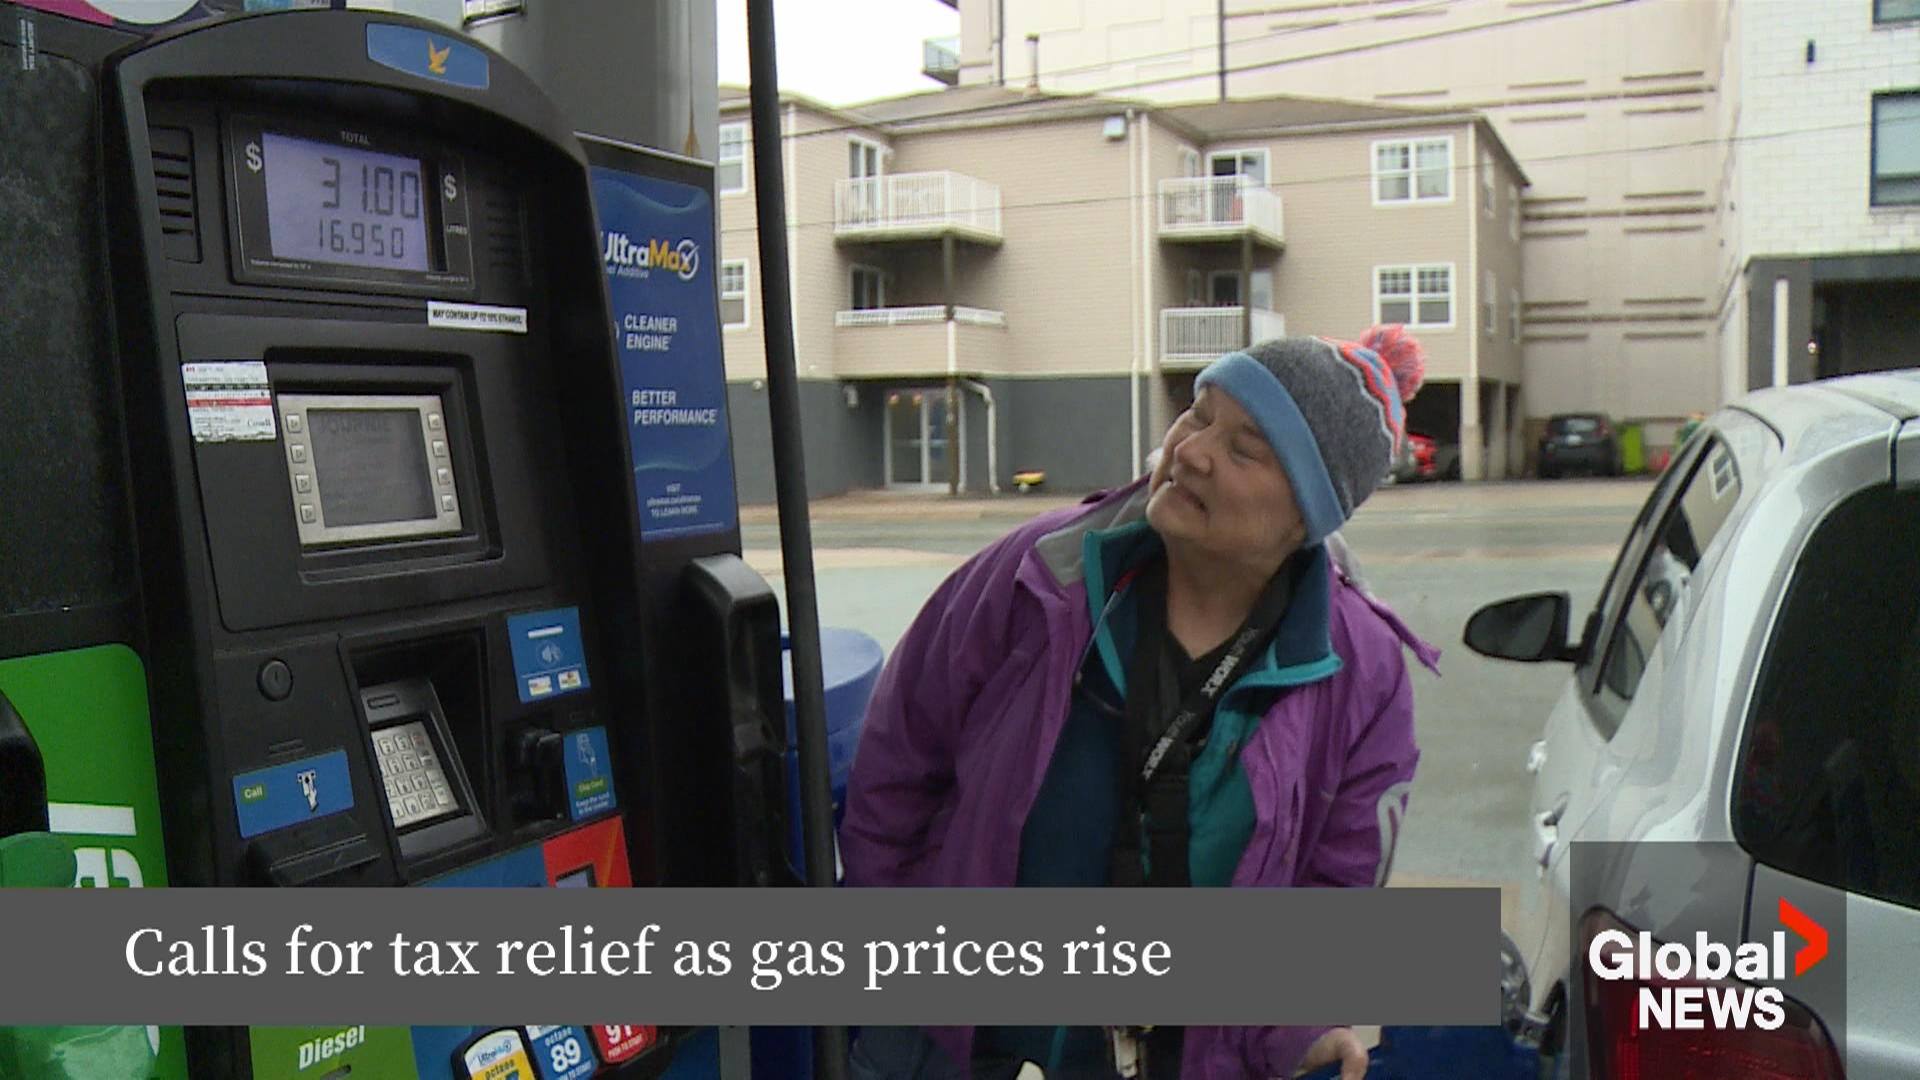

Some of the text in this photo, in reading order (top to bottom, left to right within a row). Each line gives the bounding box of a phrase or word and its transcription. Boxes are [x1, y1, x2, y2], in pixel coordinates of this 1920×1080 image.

[245, 142, 263, 173] $
[444, 174, 457, 201] $
[318, 218, 405, 259] 16.950
[624, 314, 677, 333] CLEANER
[632, 389, 677, 406] BETTER
[634, 408, 717, 425] PERFORMANCE
[244, 784, 264, 799] Call
[298, 1025, 366, 1070] Diesel
[550, 1037, 581, 1073] 89
